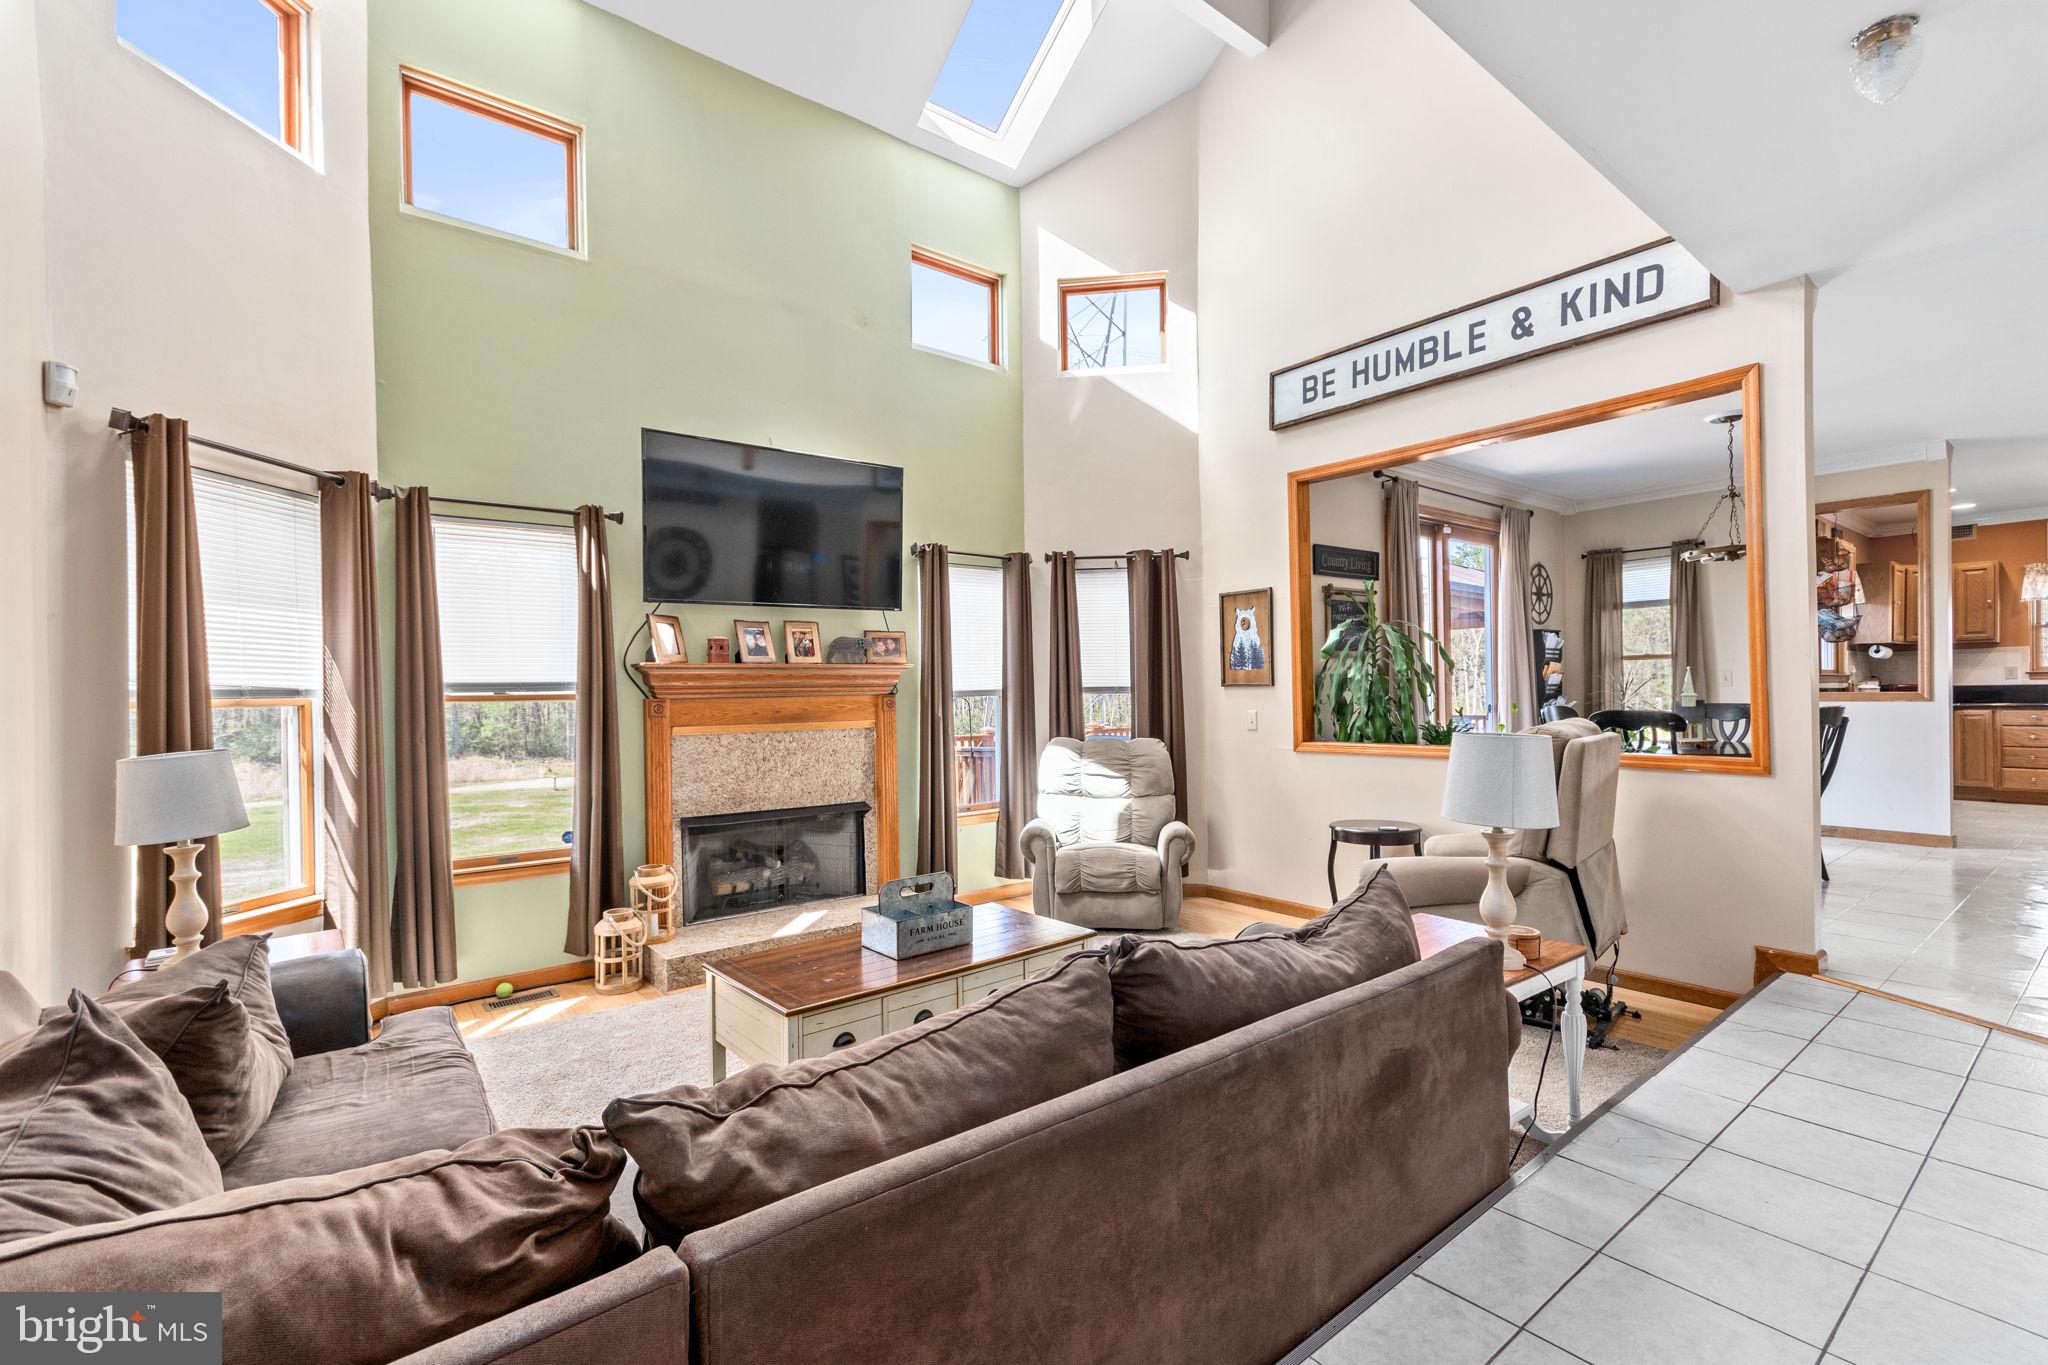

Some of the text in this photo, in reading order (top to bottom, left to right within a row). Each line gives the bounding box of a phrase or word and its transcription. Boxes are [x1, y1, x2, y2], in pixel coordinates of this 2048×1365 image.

[1302, 263, 1665, 405] BE HUMBLE & KIND
[1321, 552, 1372, 573] Country Living
[909, 925, 934, 937] FARM
[936, 918, 964, 931] HOUSE
